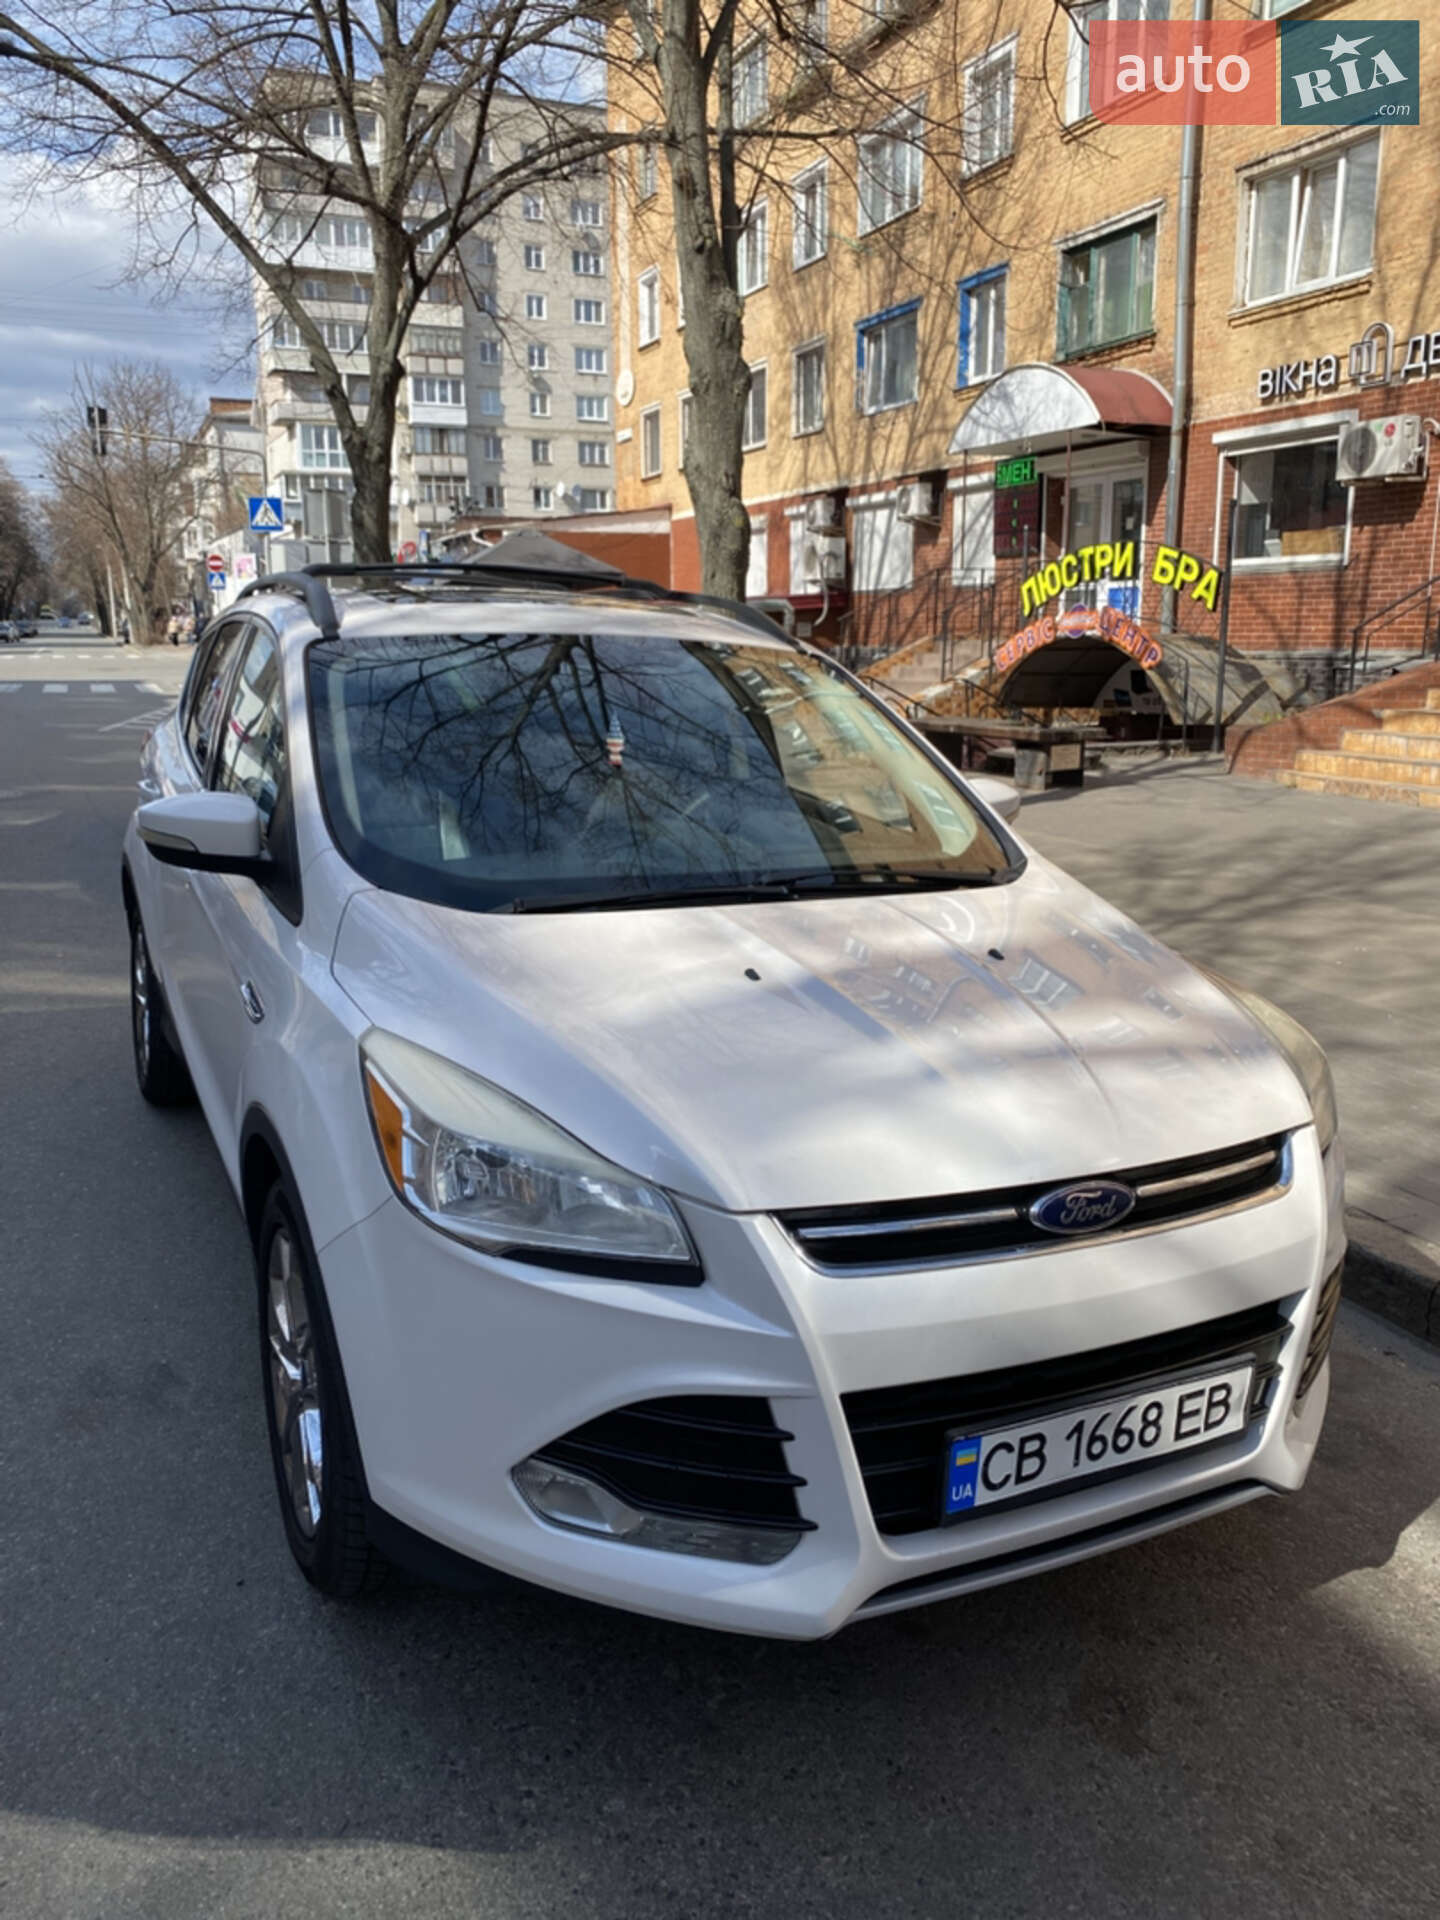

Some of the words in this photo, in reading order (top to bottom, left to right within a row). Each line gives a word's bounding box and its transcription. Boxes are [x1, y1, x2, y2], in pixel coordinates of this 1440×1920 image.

[1020, 541, 1135, 617] ЛЮСТРИ
[1152, 545, 1220, 611] БРА
[1100, 609, 1160, 664] ЦЕНТР
[1060, 1190, 1117, 1224] Ford
[981, 1432, 1047, 1491] CB
[1065, 1401, 1163, 1467] 1668
[1174, 1382, 1232, 1442] EB
[952, 1481, 973, 1500] UA
